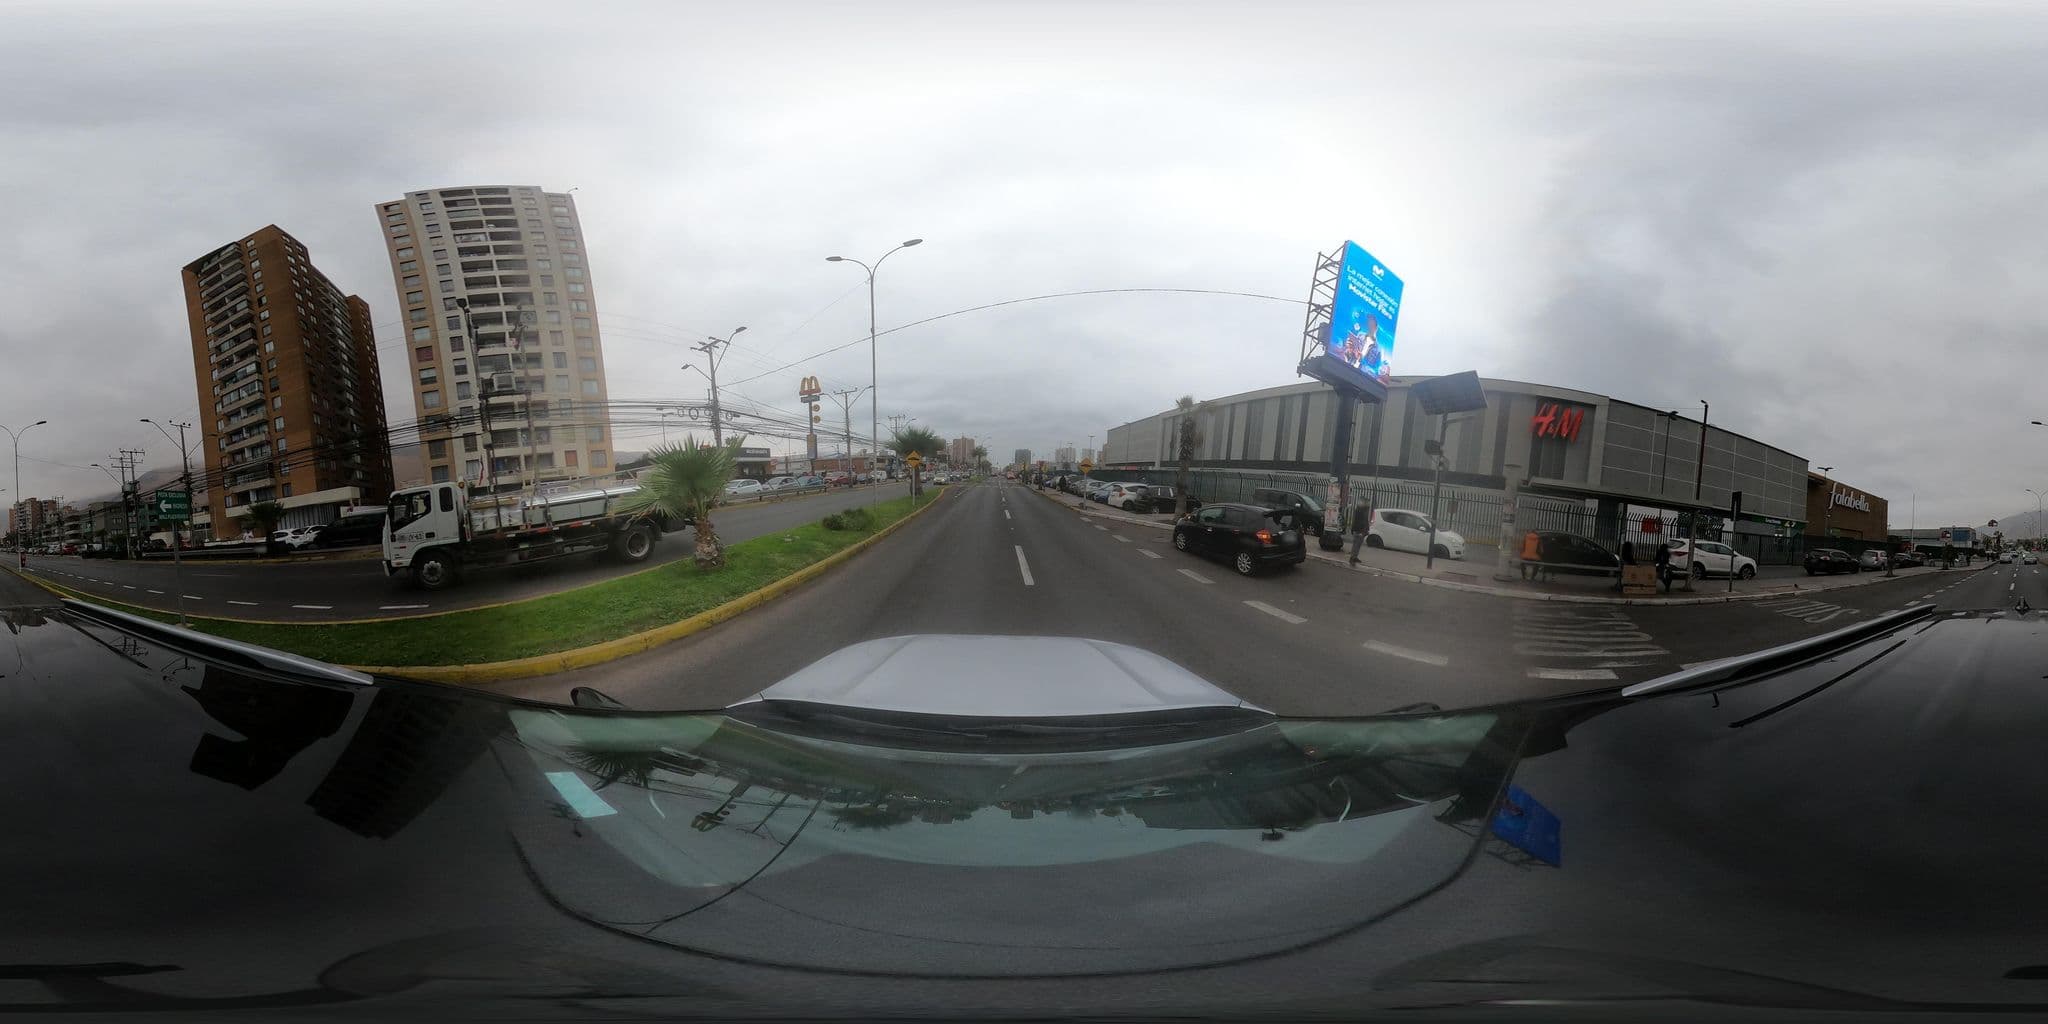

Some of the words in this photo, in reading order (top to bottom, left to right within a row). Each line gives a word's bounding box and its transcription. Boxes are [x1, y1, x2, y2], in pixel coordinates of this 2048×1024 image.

[1347, 265, 1356, 275] La
[1356, 273, 1375, 288] mejor
[1349, 283, 1378, 308] Movistar
[1378, 302, 1392, 319] Fibra
[1529, 402, 1585, 443] H&M
